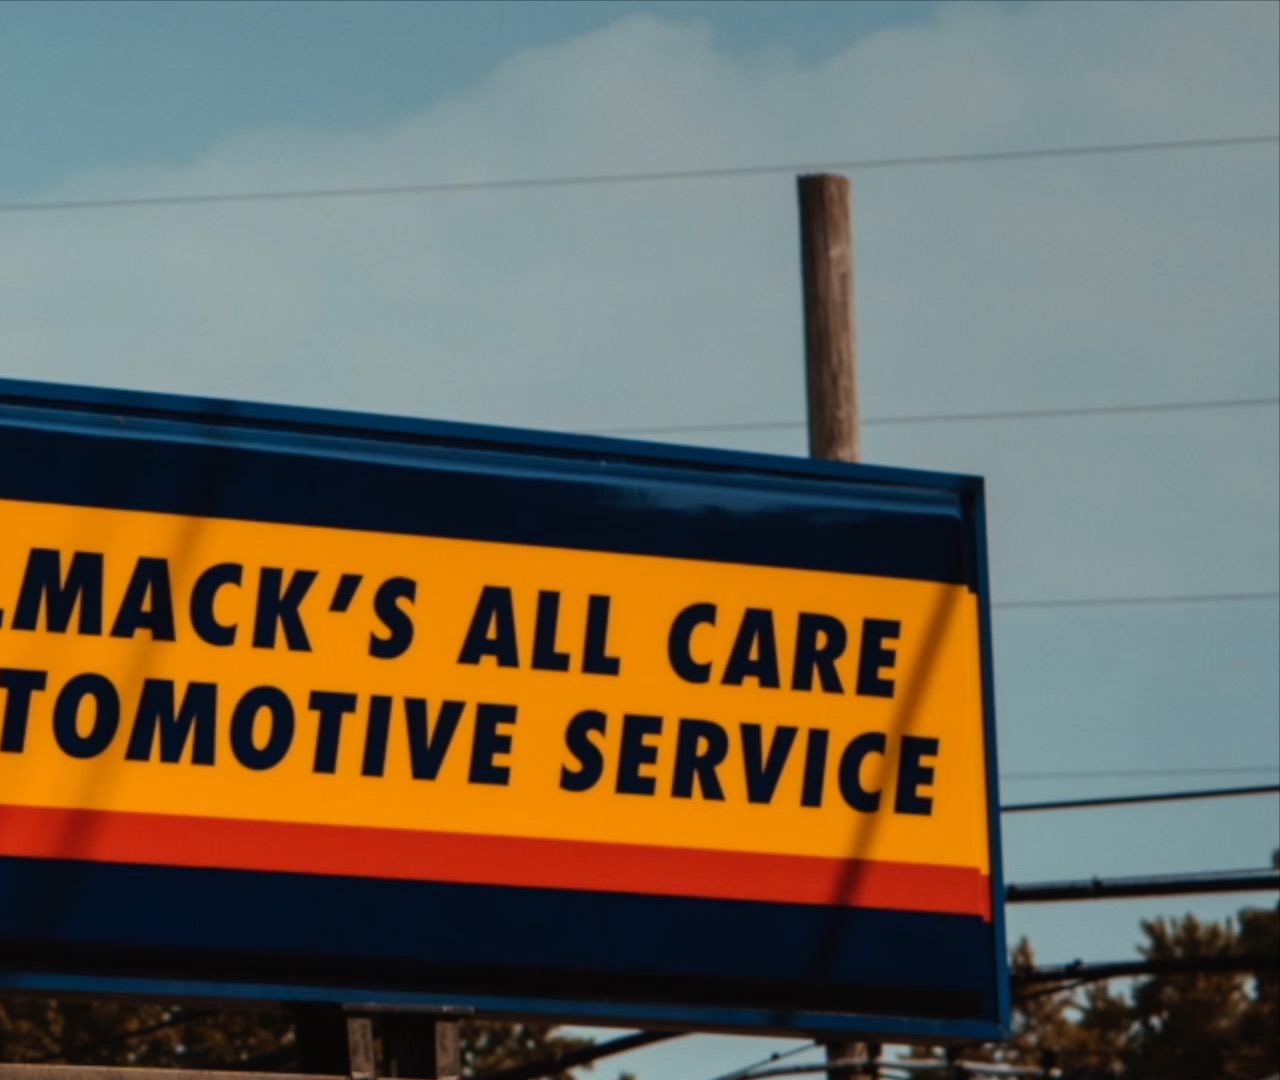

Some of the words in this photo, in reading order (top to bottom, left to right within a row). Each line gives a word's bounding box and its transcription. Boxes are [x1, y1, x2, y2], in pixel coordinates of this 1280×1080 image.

[457, 585, 622, 676] ALL
[668, 602, 902, 699] CARE
[560, 710, 940, 816] SERVICE
